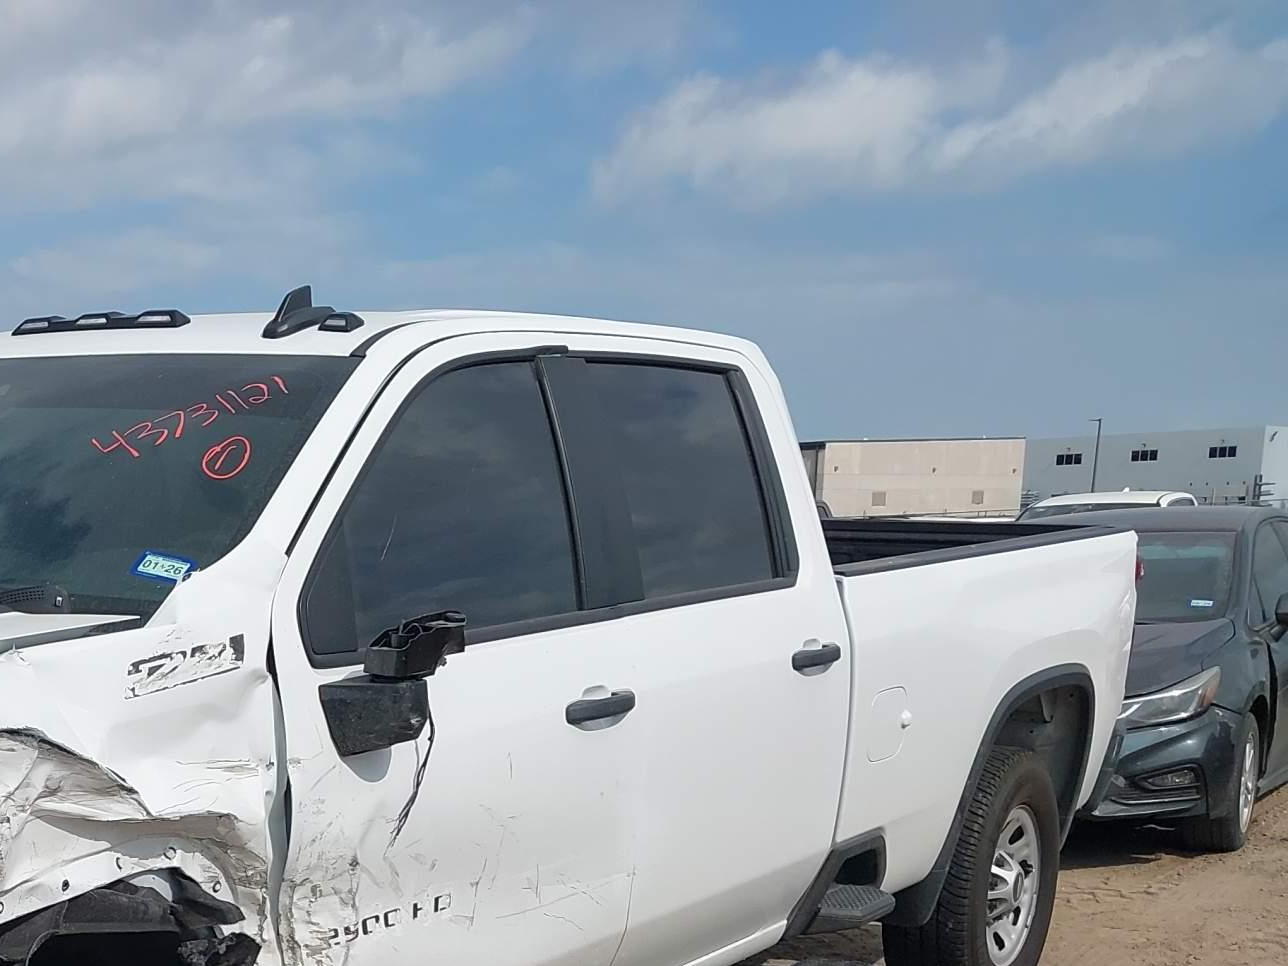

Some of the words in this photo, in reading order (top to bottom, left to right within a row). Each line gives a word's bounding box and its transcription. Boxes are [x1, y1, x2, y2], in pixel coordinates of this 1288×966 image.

[90, 375, 289, 458] 43731121
[142, 559, 159, 570] 01
[163, 564, 184, 575] 26
